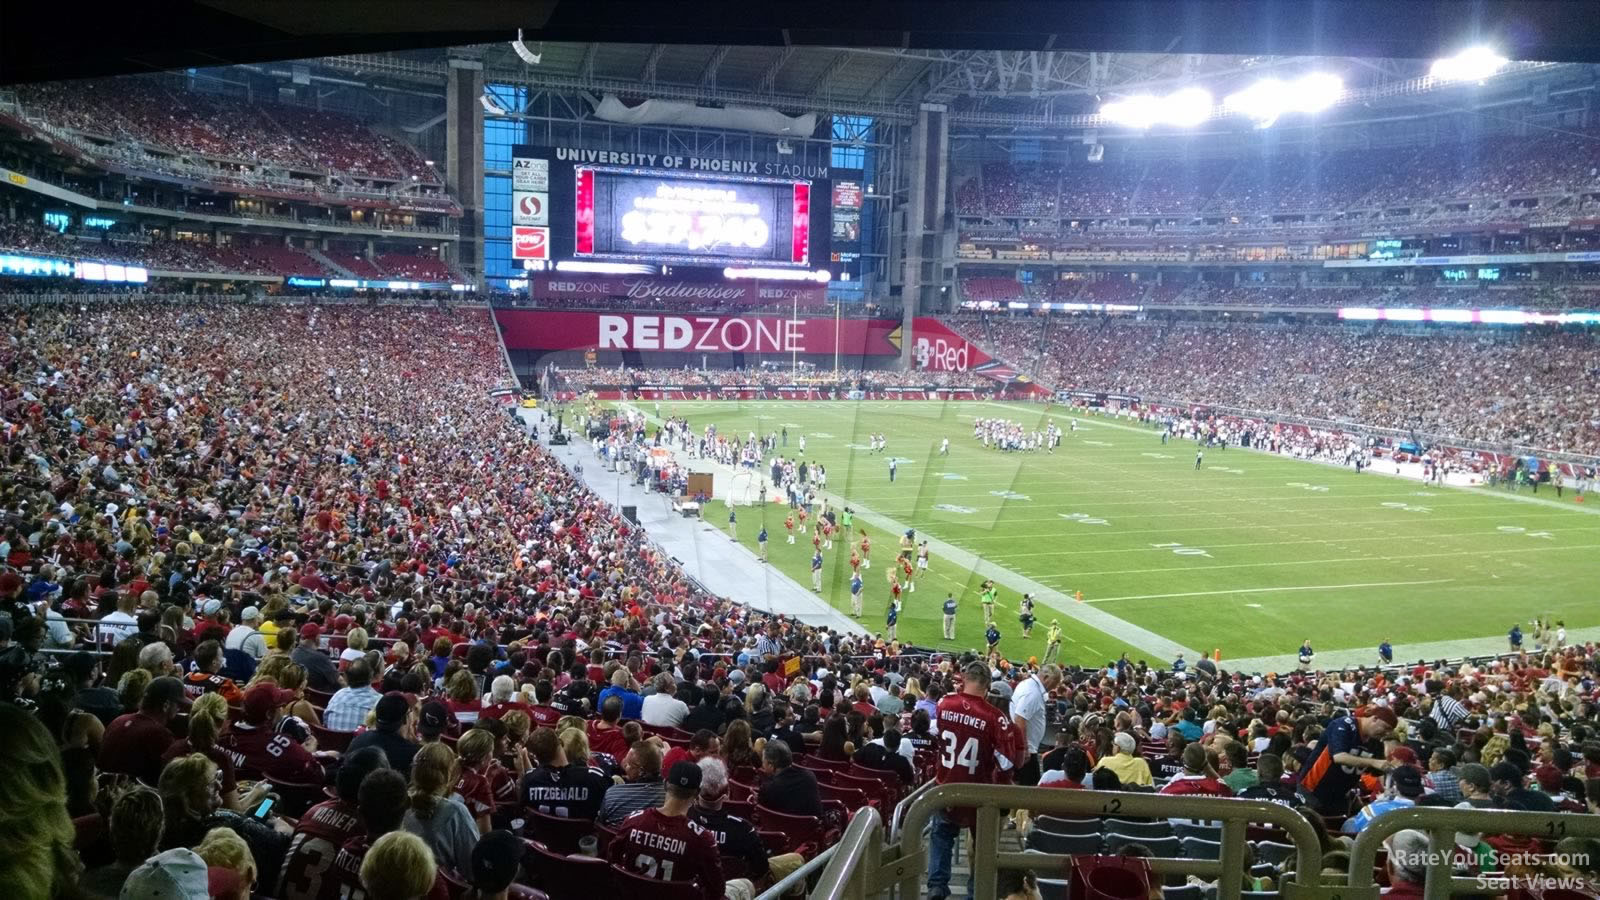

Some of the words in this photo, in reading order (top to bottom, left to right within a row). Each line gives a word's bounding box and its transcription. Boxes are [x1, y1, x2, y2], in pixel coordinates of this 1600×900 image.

[556, 147, 657, 167] UNIVERSITY
[663, 156, 683, 168] OF
[690, 158, 758, 174] PHOENIX
[765, 163, 828, 178] STADIUM
[549, 281, 610, 294] REDZONE
[622, 277, 746, 299] Budweiser
[759, 288, 814, 300] REDZONE
[599, 315, 806, 351] REDZONE
[935, 339, 969, 372] Red
[941, 709, 987, 731] HIGHTOWER
[266, 734, 291, 757] 65
[941, 730, 980, 775] 34
[1161, 764, 1185, 774] PETERS
[529, 786, 589, 801] FITZGERALD
[629, 828, 687, 856] PETERSON
